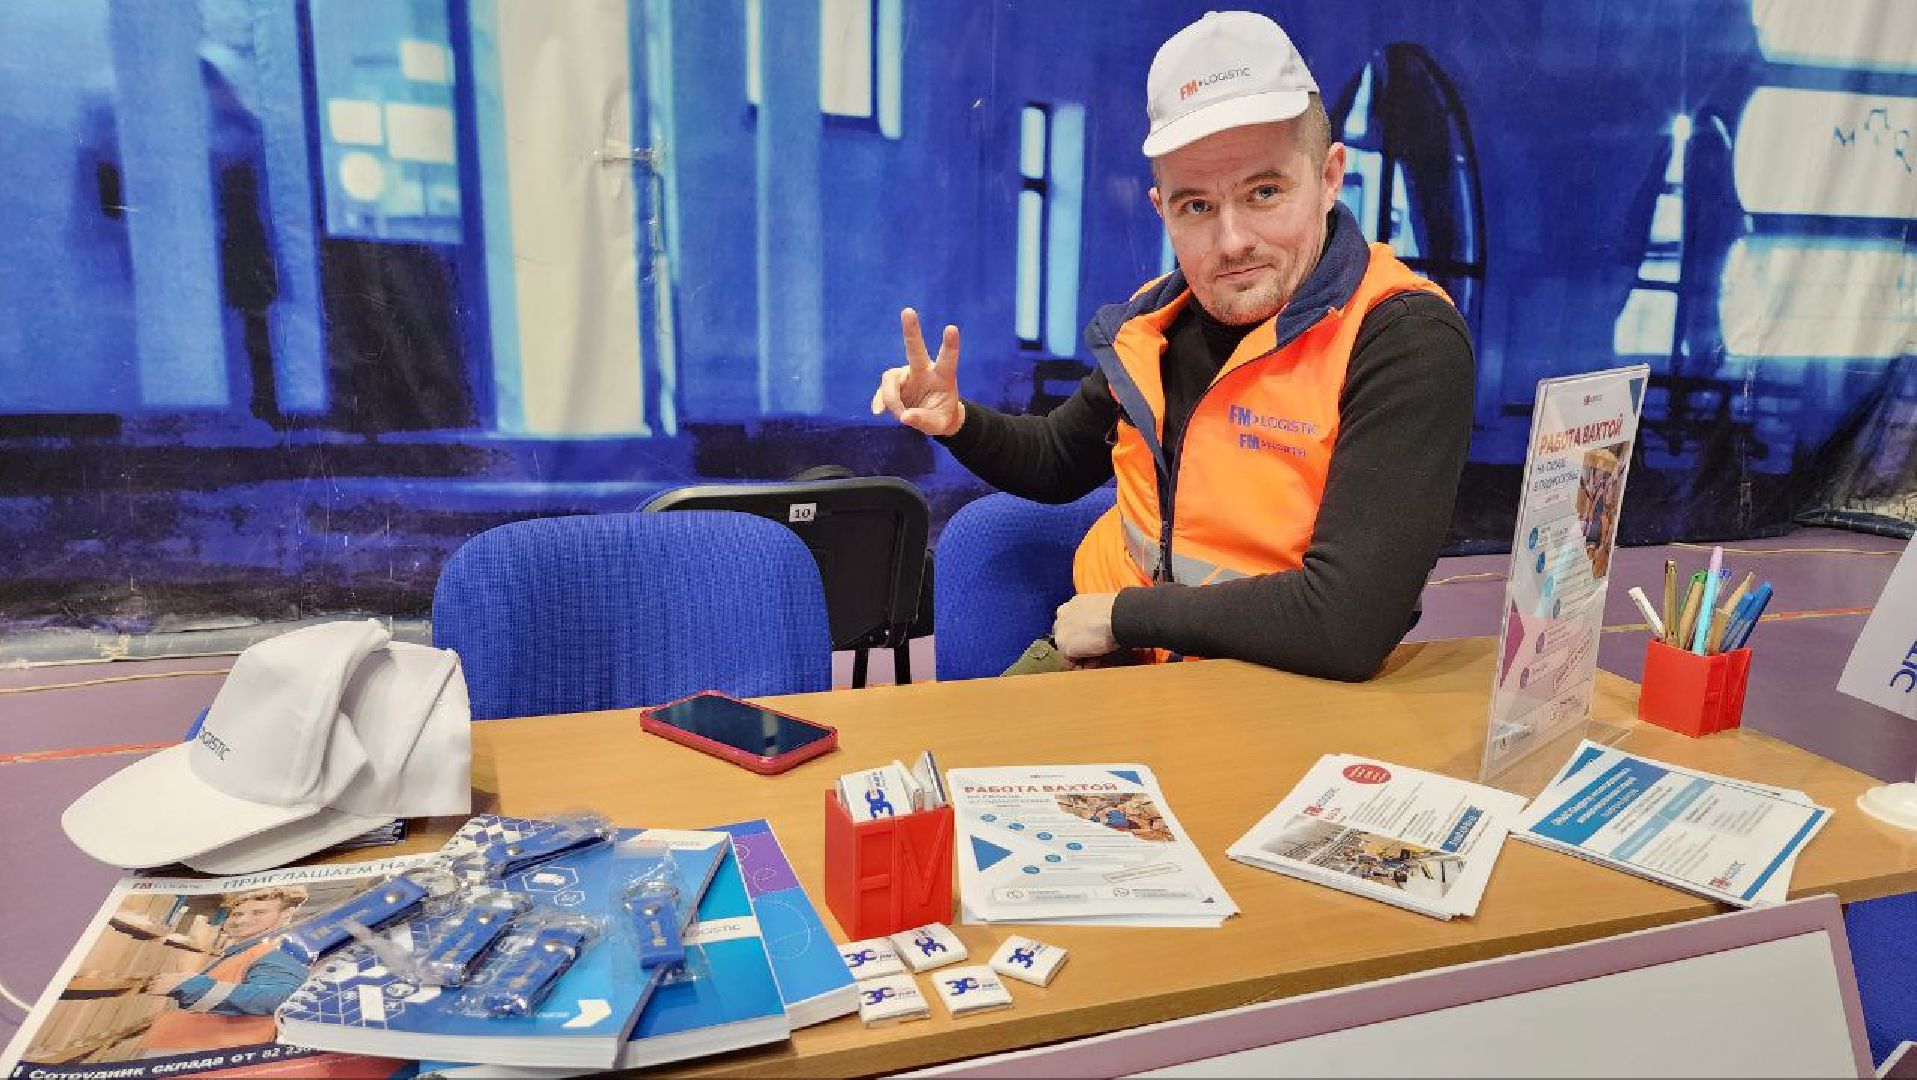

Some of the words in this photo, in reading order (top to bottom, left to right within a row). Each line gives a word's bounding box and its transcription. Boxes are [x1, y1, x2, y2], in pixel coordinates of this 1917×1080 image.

[1180, 80, 1198, 101] FM
[1203, 67, 1251, 86] LOGISTIC
[1230, 404, 1251, 427] FM
[1261, 416, 1320, 435] LOGISTIC
[1239, 433, 1260, 450] FM
[1539, 427, 1581, 455] РАБОТА
[1582, 412, 1624, 444] ВАХТОЙ
[795, 509, 810, 519] 10
[223, 864, 373, 889] ПРИГЛАШАЕМ
[151, 1056, 224, 1075] склада
